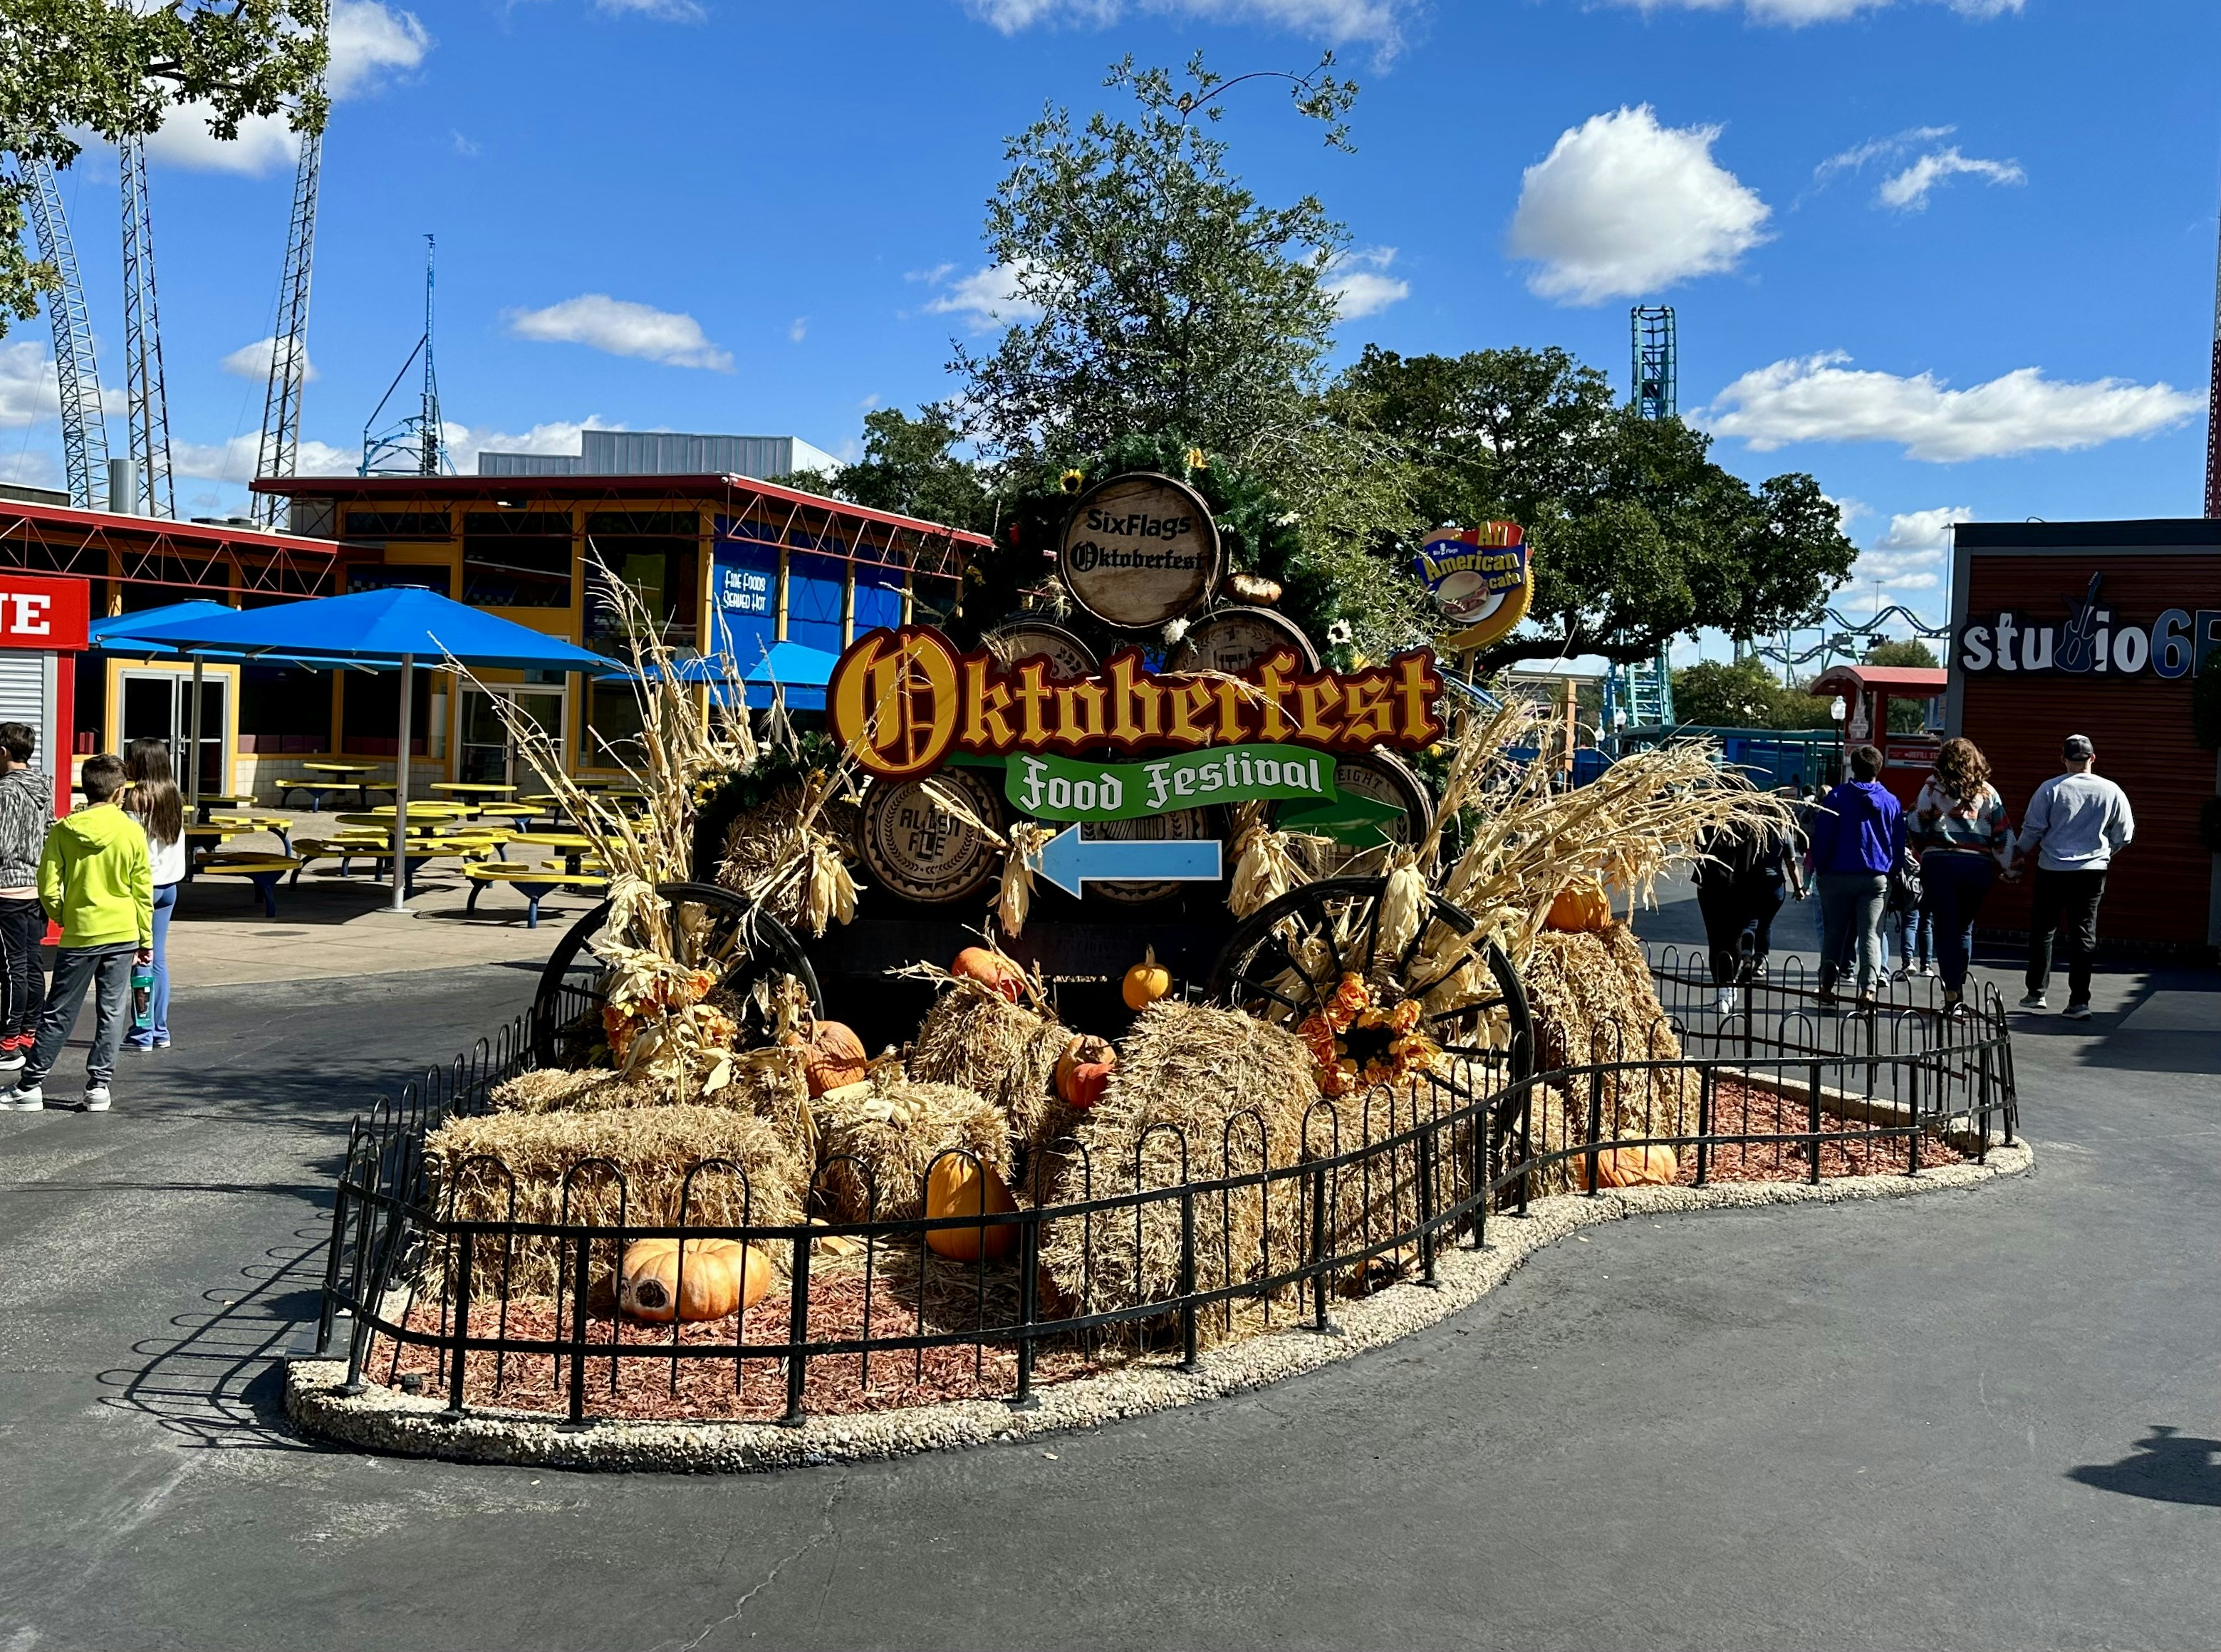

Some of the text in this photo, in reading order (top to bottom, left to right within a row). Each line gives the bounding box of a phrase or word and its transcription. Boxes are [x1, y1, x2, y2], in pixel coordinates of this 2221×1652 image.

[1070, 541, 1205, 572] Oktoberfest
[1423, 551, 1520, 582] American
[1488, 571, 1521, 589] cafe
[836, 633, 1440, 774] Oktoberfest
[1019, 752, 1323, 811] Food Festival
